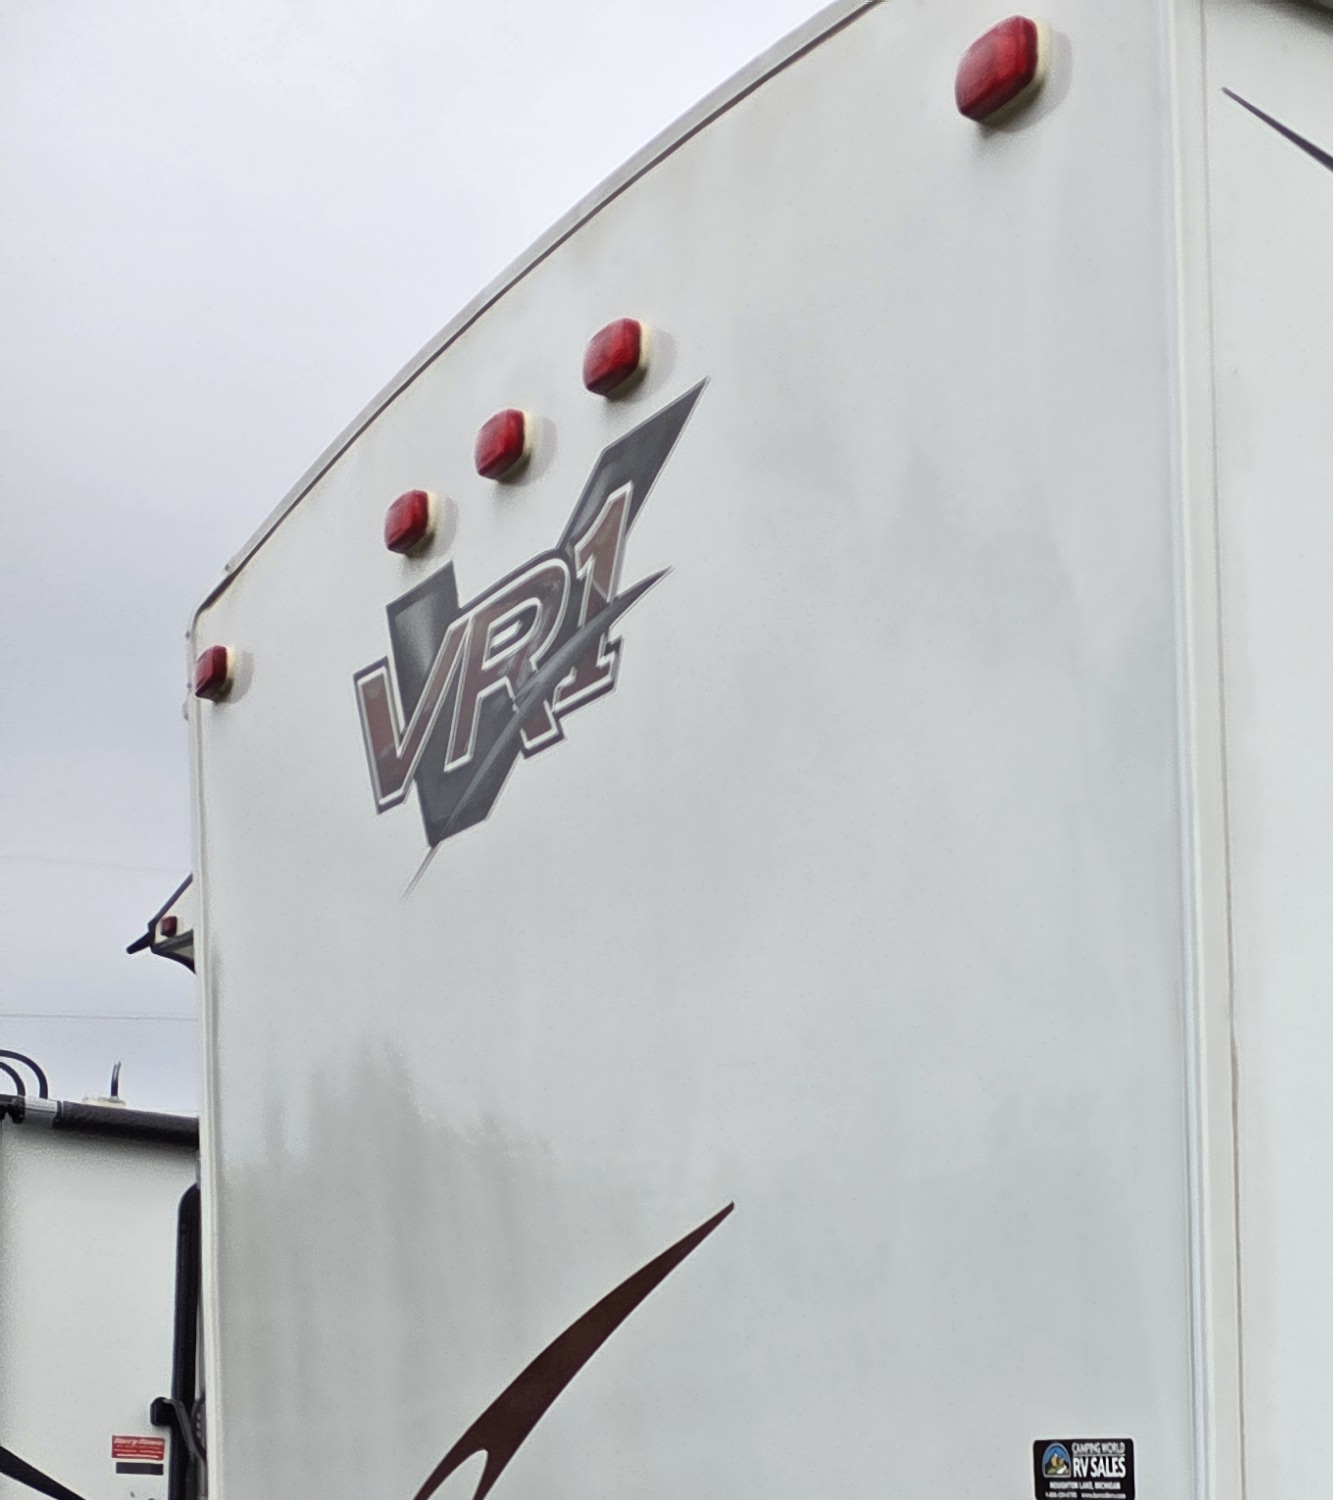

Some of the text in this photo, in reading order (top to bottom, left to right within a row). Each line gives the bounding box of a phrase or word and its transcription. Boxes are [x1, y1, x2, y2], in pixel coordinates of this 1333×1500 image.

[353, 481, 634, 815] VR1
[1071, 1442, 1126, 1454] CAMPING WORLD
[1073, 1456, 1126, 1478] RV SALES
